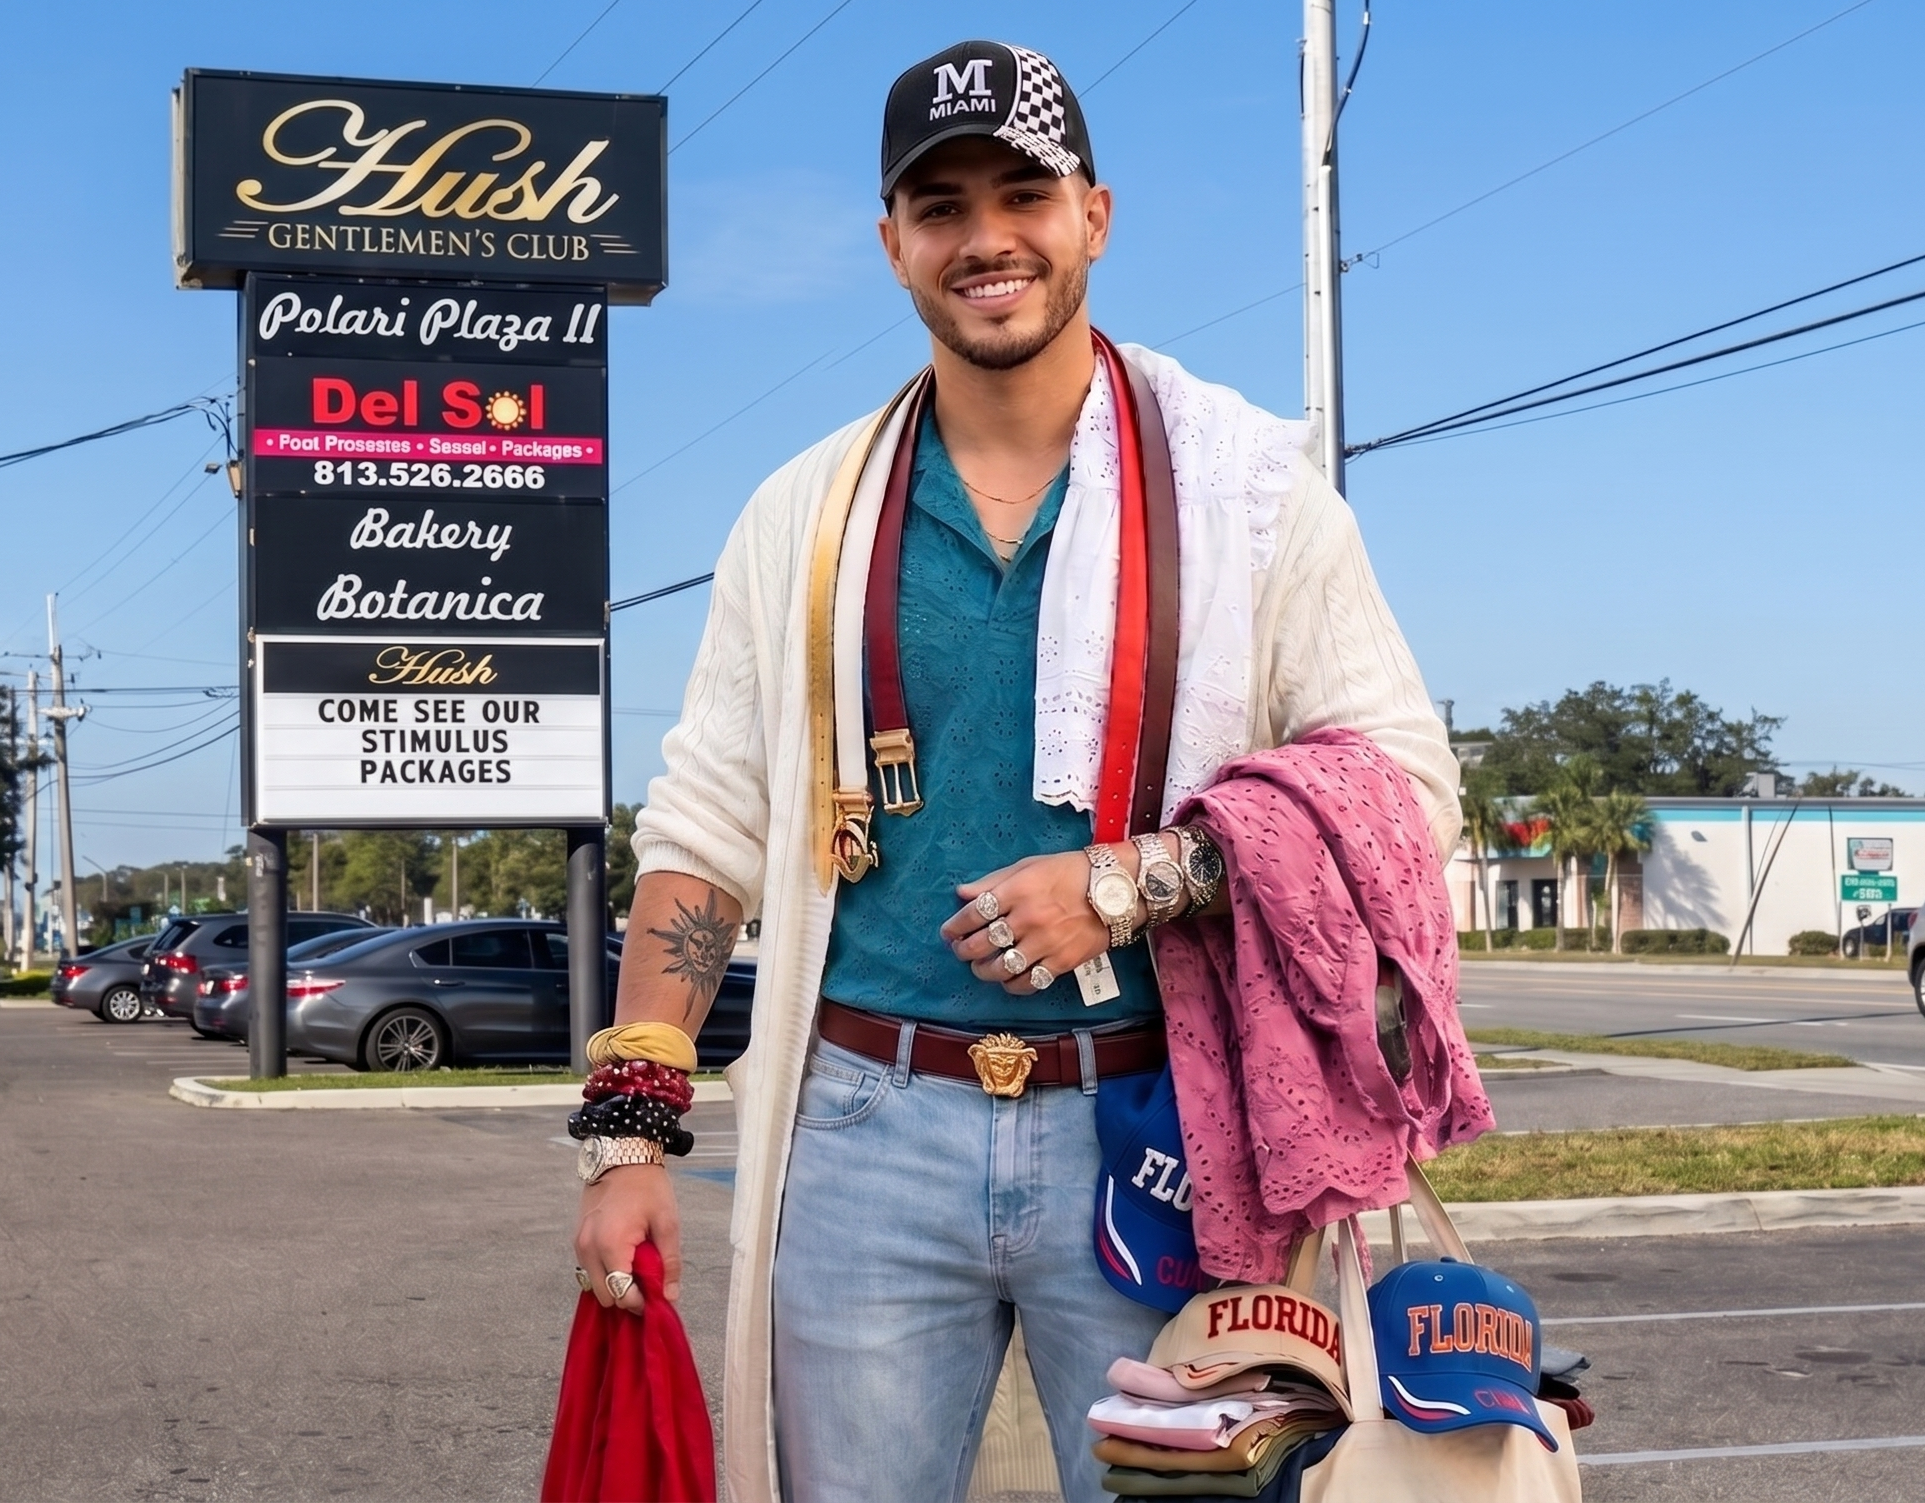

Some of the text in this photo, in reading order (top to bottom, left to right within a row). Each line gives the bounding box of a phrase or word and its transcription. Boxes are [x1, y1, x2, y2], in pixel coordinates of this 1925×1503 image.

[932, 59, 993, 104] M
[929, 98, 996, 121] MIAMI
[236, 99, 620, 224] Hush
[267, 221, 590, 261] GENTLEMEN'S CLUB
[258, 291, 410, 340] Polari
[419, 297, 553, 351] Plaza
[312, 377, 419, 427] Del
[502, 439, 583, 461] Packages
[313, 460, 546, 490] 813.526.2666
[349, 507, 513, 562] Bakery
[316, 573, 546, 621] Botanica
[368, 645, 499, 685] Hush
[318, 698, 541, 724] COME SEE OUR
[361, 729, 509, 754] STIMULUS
[360, 759, 512, 784] PACKAGES
[1207, 1294, 1342, 1368] FLORIDA
[1407, 1302, 1533, 1374] FLORIDA
